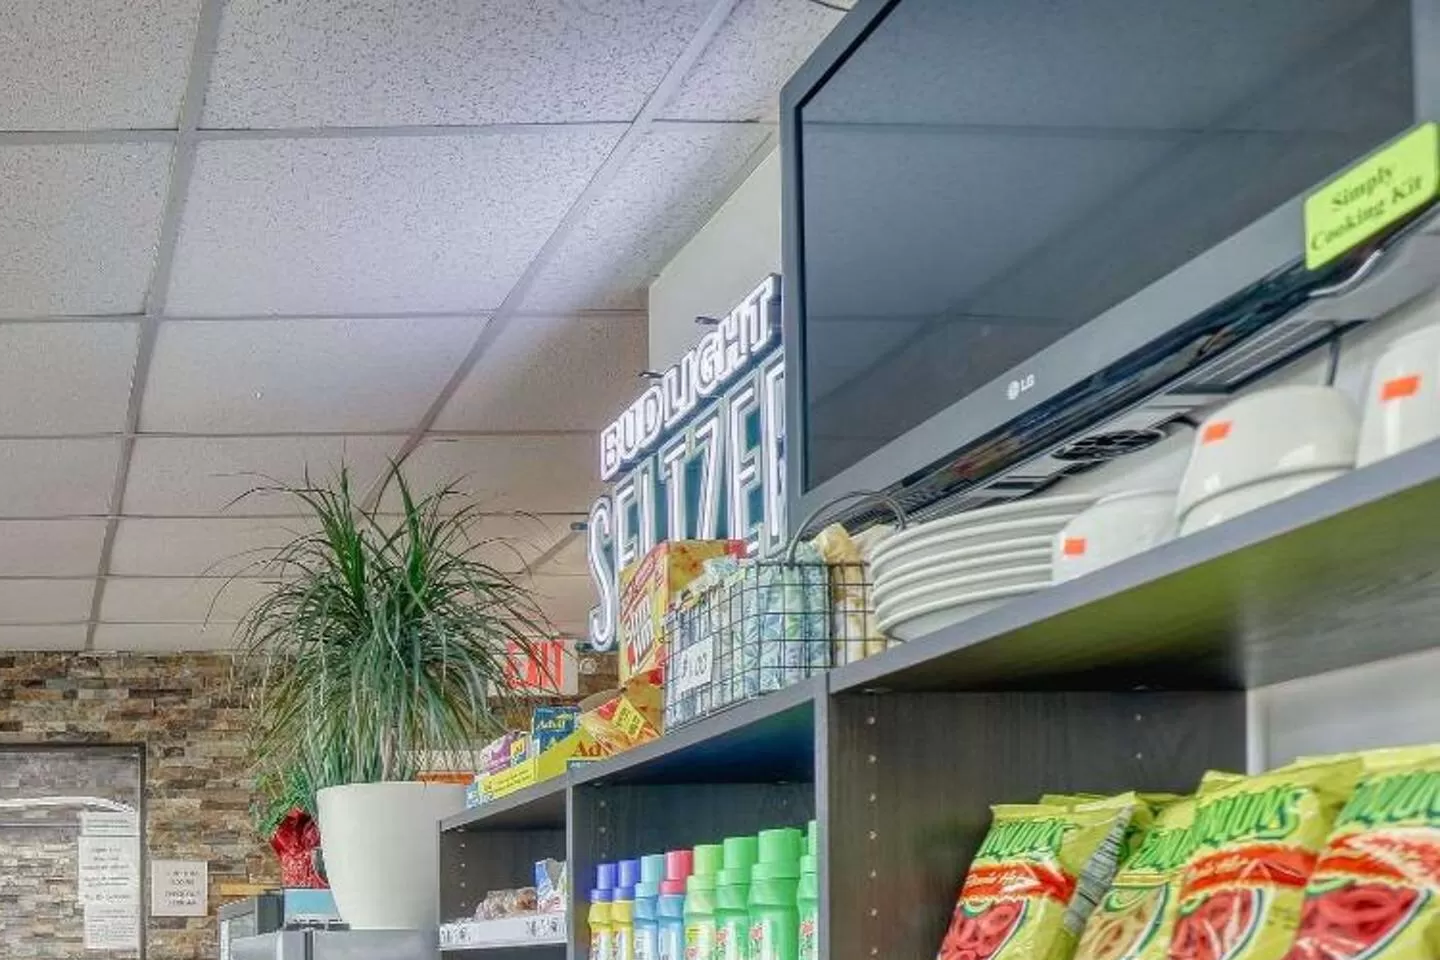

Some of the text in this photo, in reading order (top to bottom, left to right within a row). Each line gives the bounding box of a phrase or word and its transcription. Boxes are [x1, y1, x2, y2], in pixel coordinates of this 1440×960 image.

[1311, 174, 1423, 251] Cooking Kit
[1331, 163, 1396, 213] Simply
[1020, 374, 1035, 392] LG
